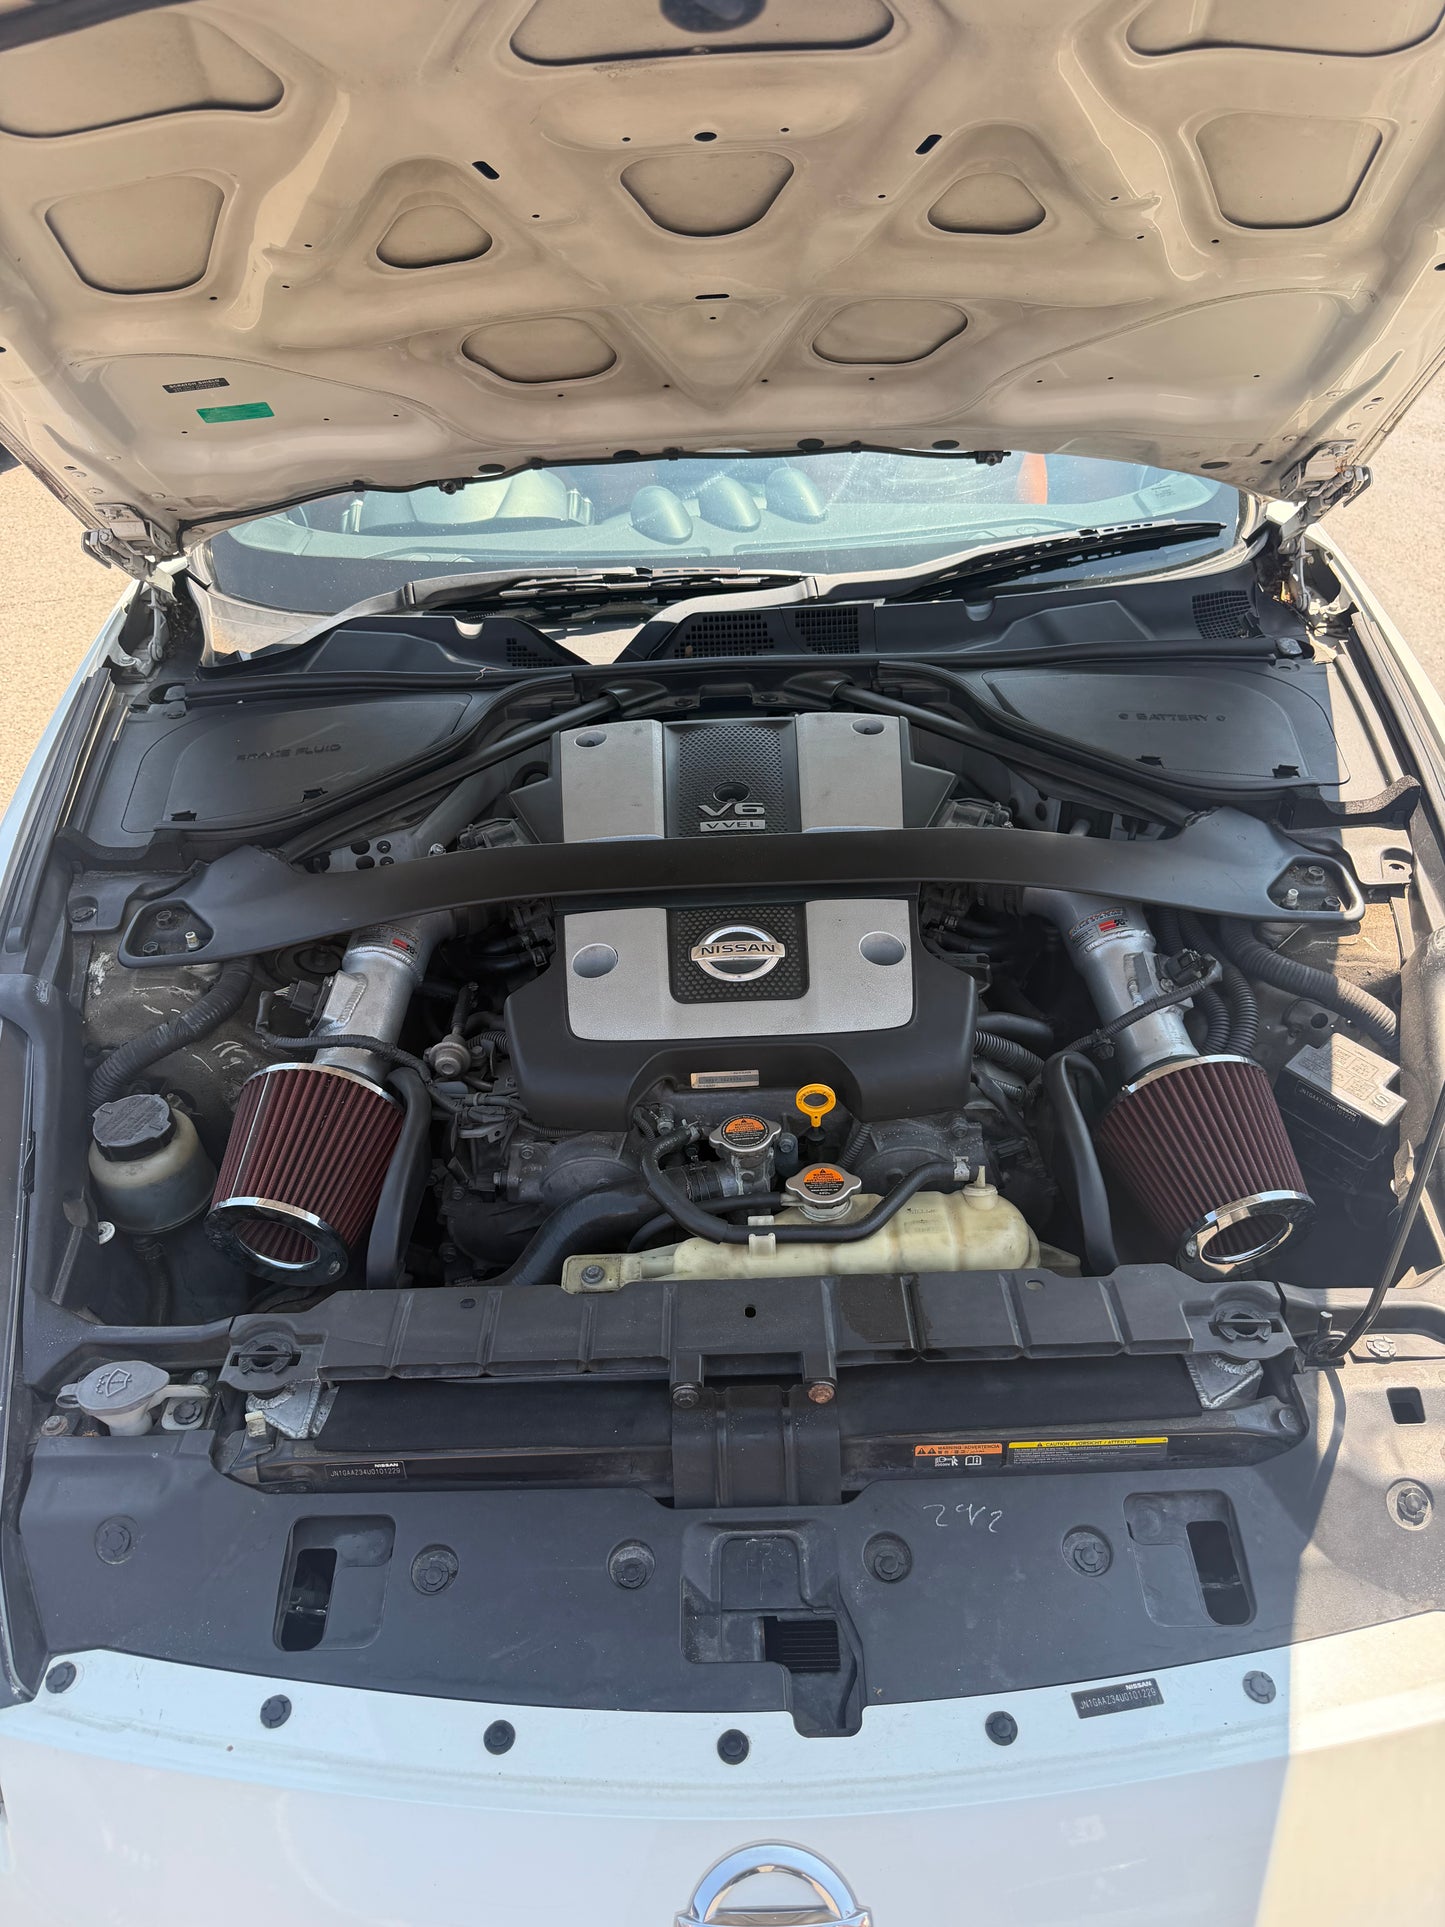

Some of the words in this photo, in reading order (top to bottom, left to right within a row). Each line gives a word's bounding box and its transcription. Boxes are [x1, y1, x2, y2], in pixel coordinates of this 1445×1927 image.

[1135, 712, 1209, 721] BATTERY
[295, 743, 341, 756] FLUID
[698, 802, 765, 817] V6
[706, 821, 760, 829] VVEL
[701, 943, 775, 956] NISSAN
[1125, 1680, 1152, 1690] NISSAN
